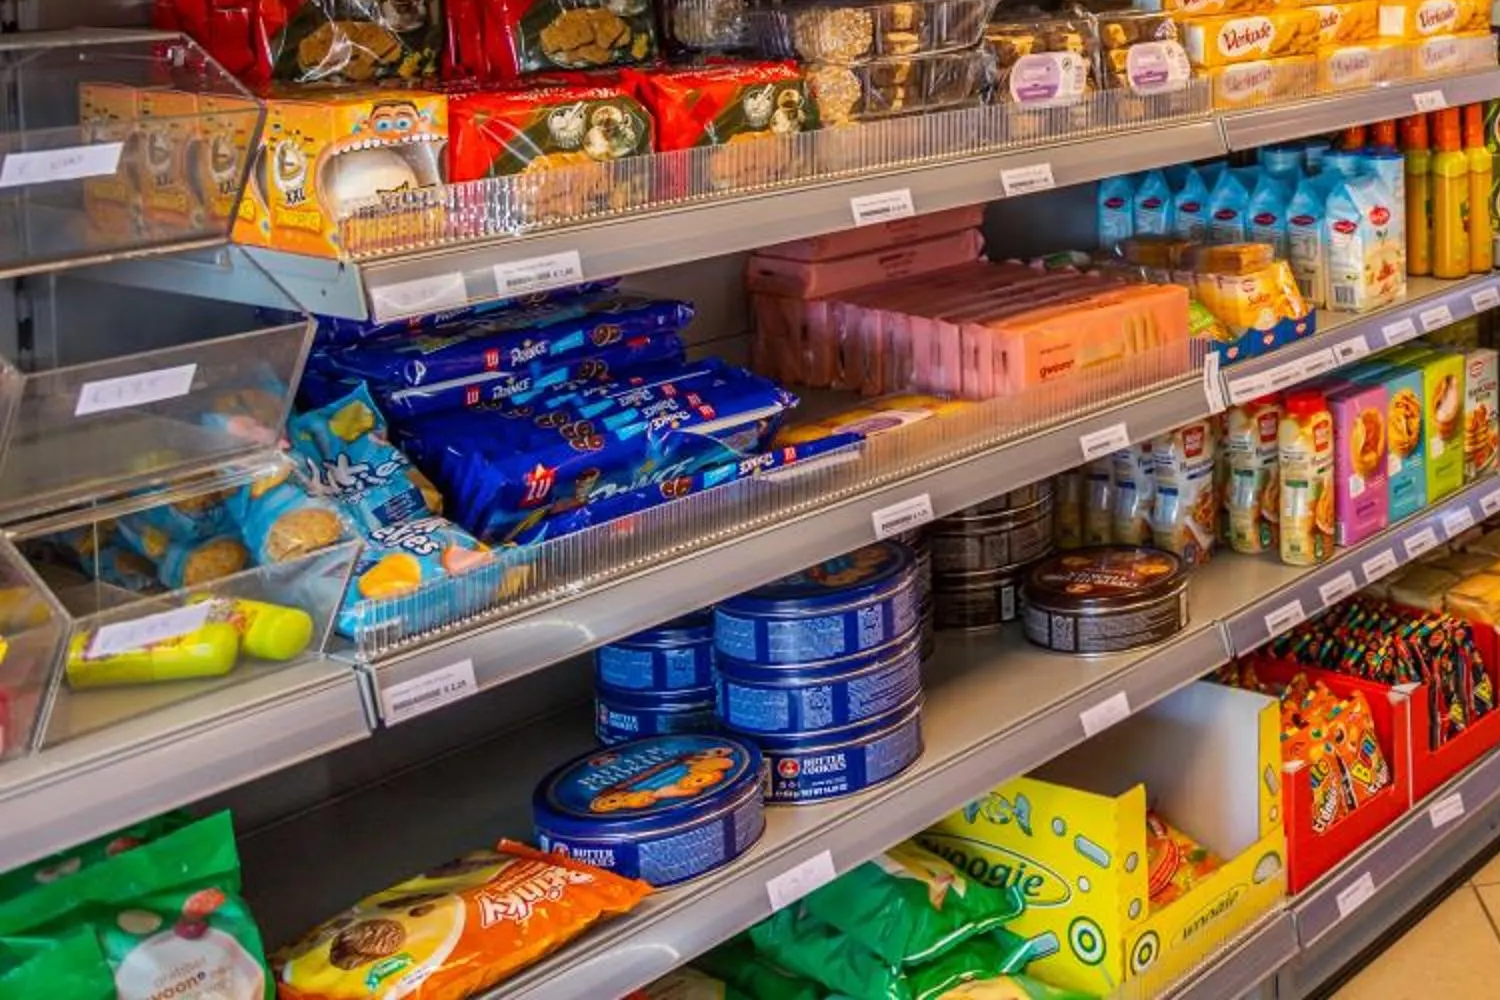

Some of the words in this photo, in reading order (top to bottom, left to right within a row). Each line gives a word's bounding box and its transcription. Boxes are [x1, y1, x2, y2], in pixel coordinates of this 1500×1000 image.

[285, 187, 306, 203] XXL
[803, 753, 846, 768] BUTTER
[802, 762, 846, 776] COOKIES
[572, 848, 613, 860] BUTTER
